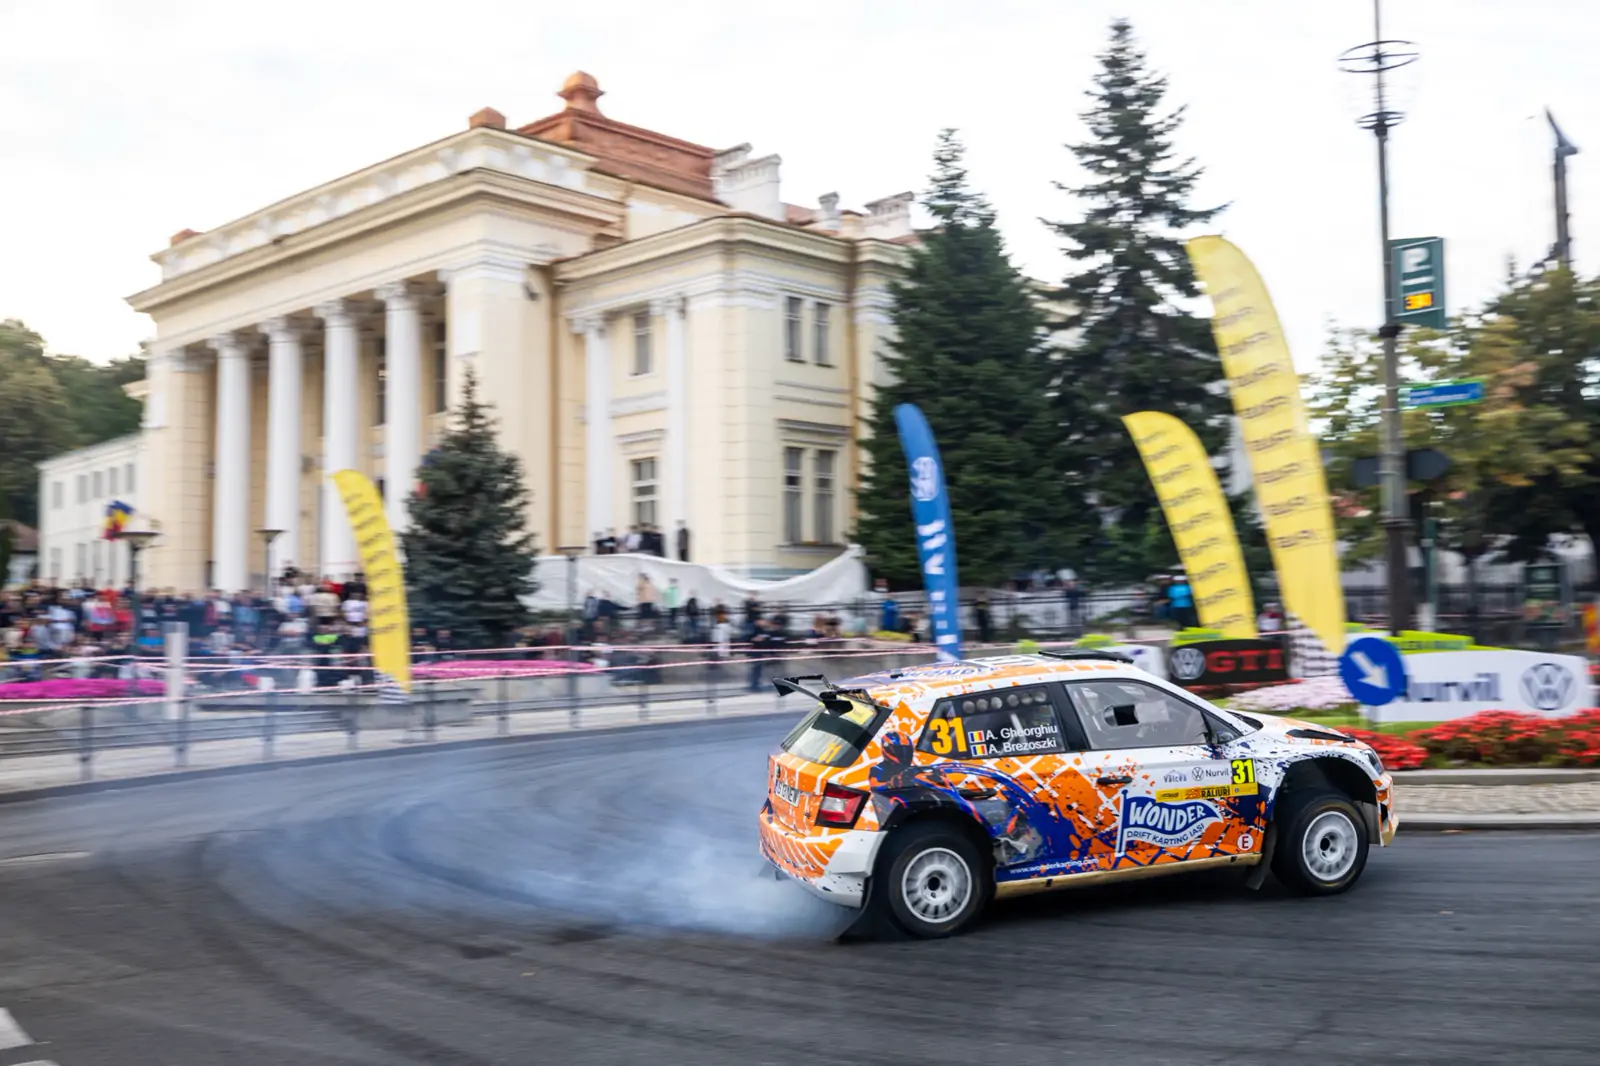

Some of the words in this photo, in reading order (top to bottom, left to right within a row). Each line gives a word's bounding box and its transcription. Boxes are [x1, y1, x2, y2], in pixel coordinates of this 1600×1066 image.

[1205, 649, 1283, 672] GTI
[929, 717, 967, 755] 31
[986, 730, 998, 740] A.
[1000, 724, 1058, 739] Gheorghiu
[989, 744, 1000, 754] A.
[1003, 737, 1057, 753] Brezoszki
[1206, 768, 1230, 777] Nurvil
[1231, 759, 1255, 784] 31
[1201, 787, 1230, 798] RALIURI
[1129, 802, 1206, 831] WONDER
[1126, 830, 1152, 839] DRIFT
[1152, 833, 1189, 845] KARTING
[1241, 835, 1249, 849] E
